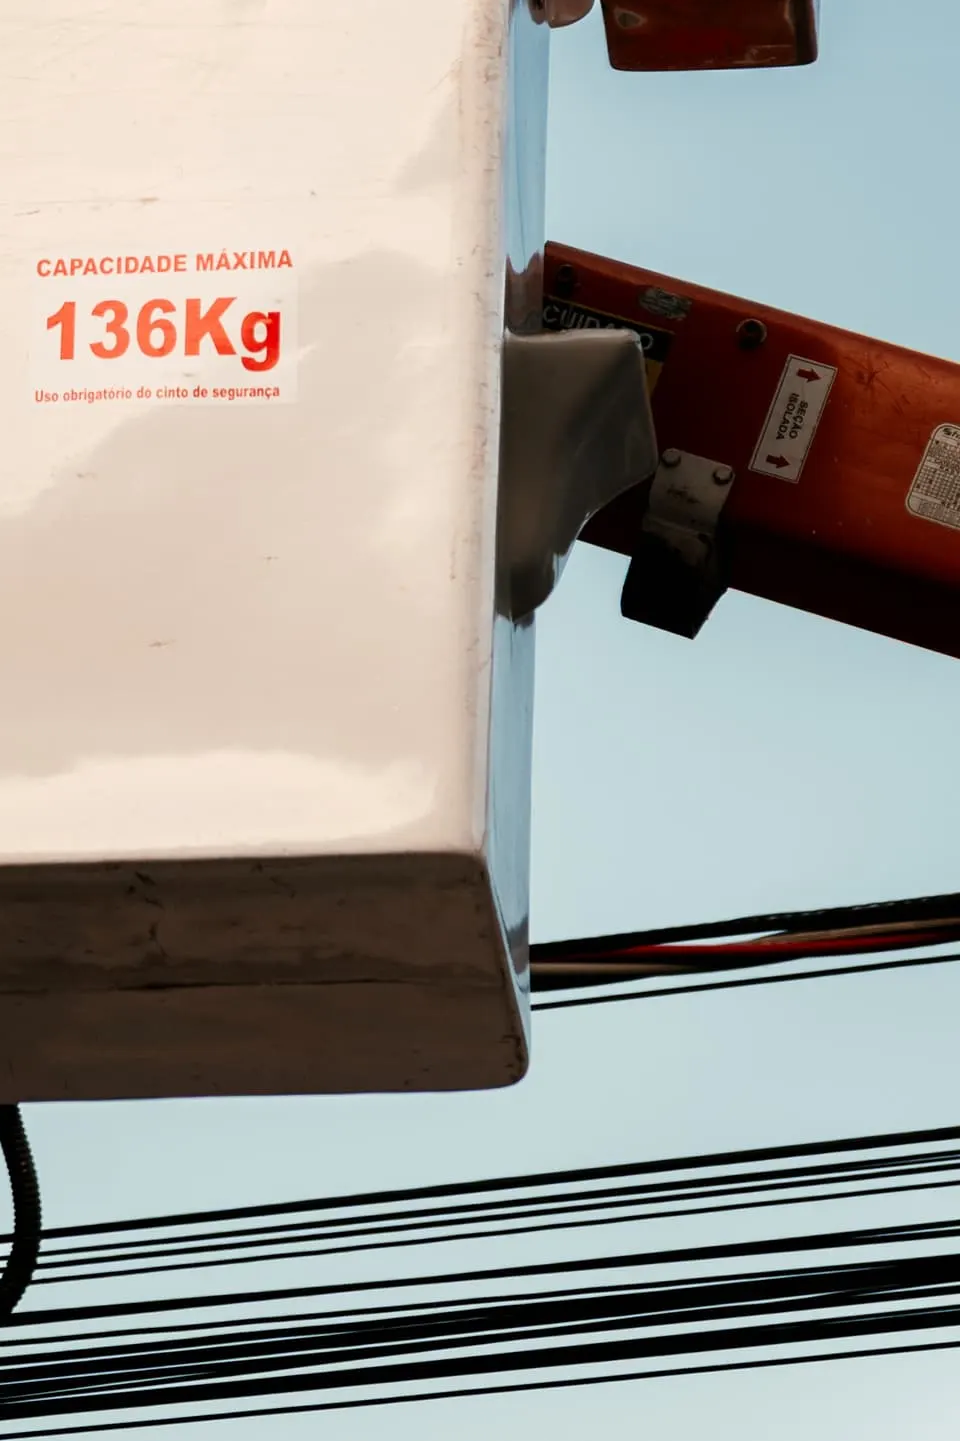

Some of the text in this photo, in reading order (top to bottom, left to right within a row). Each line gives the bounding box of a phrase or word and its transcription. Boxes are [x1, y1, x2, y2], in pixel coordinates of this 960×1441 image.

[36, 248, 293, 277] CAPACIDADE MÁXIMA
[46, 296, 281, 372] 136Kg
[543, 305, 655, 350] CUIDO
[35, 386, 280, 404] Uso obrigatório do cinto de segurança
[776, 393, 800, 440] ISOLADA
